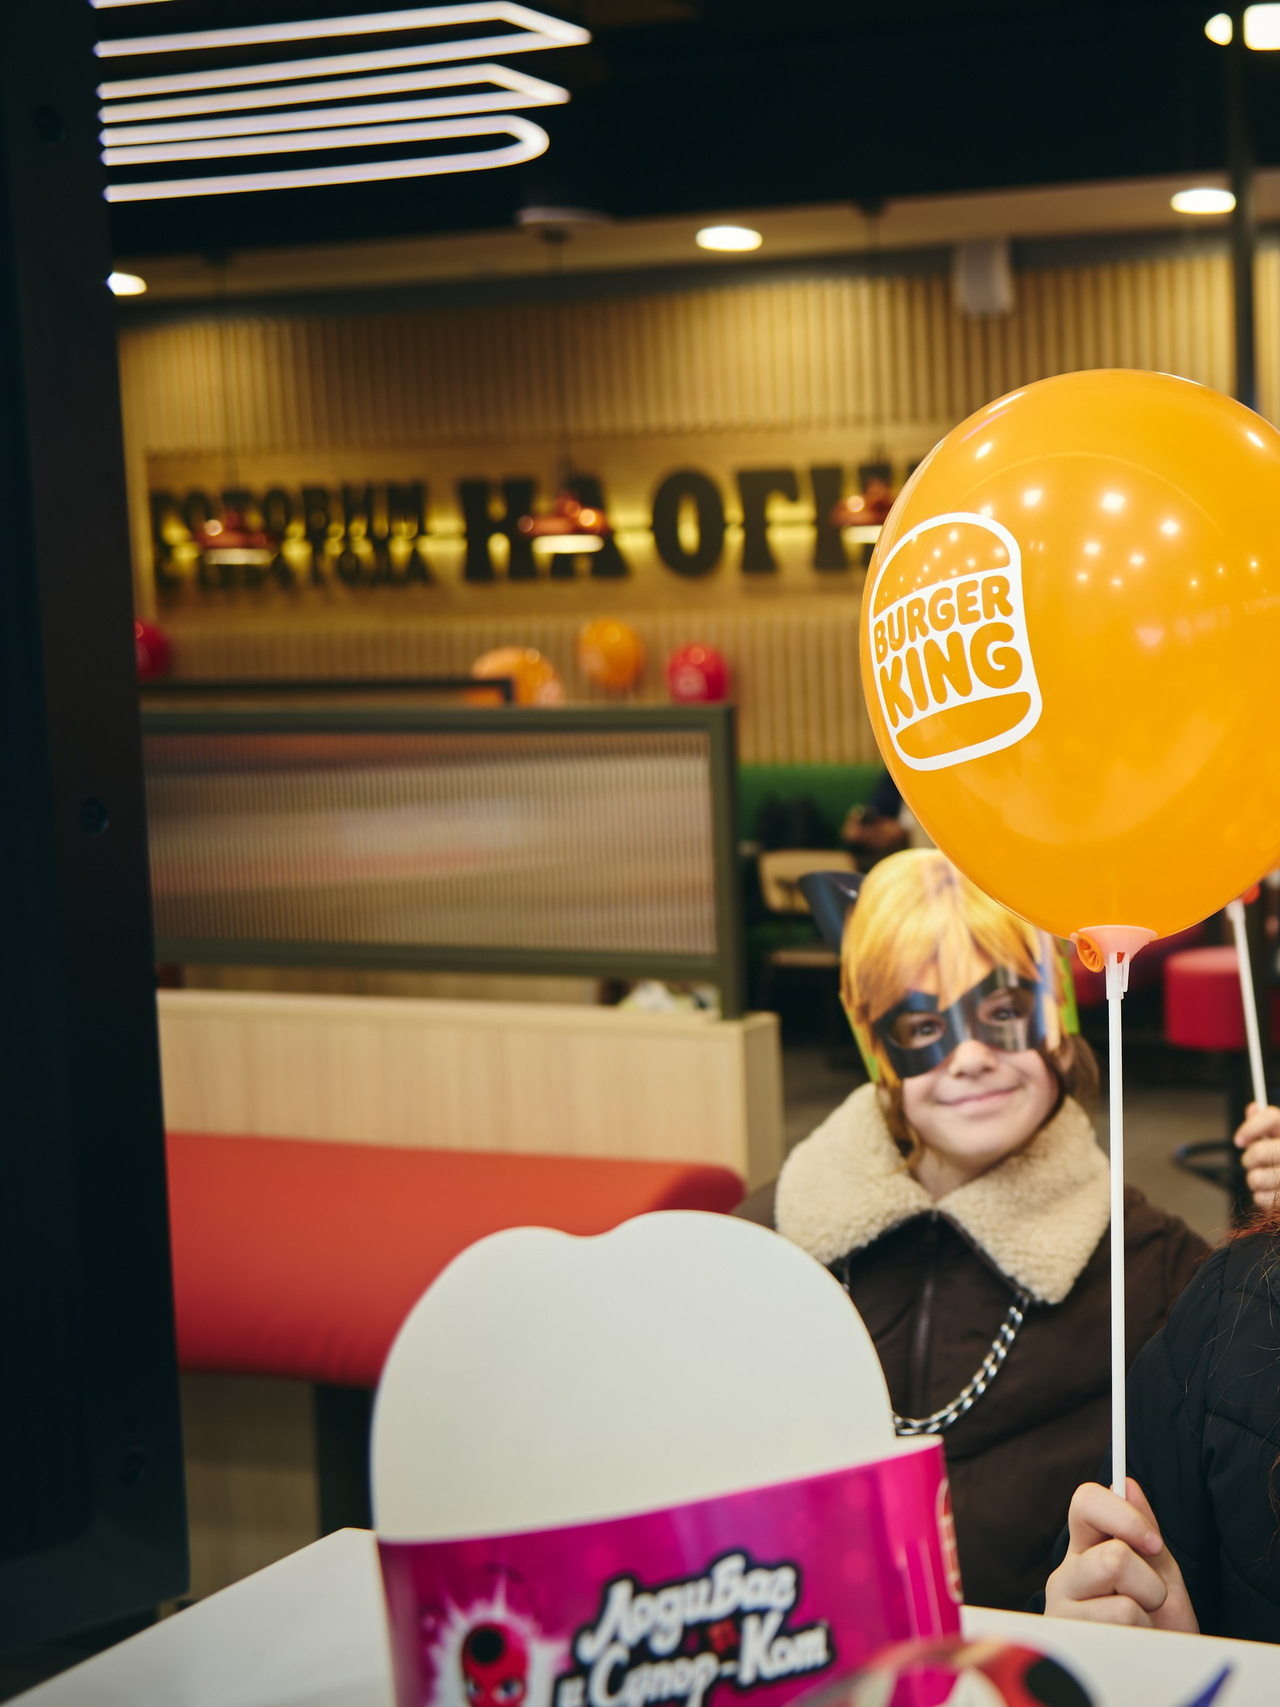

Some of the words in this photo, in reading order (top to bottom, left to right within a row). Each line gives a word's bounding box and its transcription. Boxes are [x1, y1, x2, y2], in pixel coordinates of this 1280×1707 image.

[653, 464, 920, 576] ОГН
[873, 575, 1014, 665] BURGER
[879, 622, 1023, 728] KING
